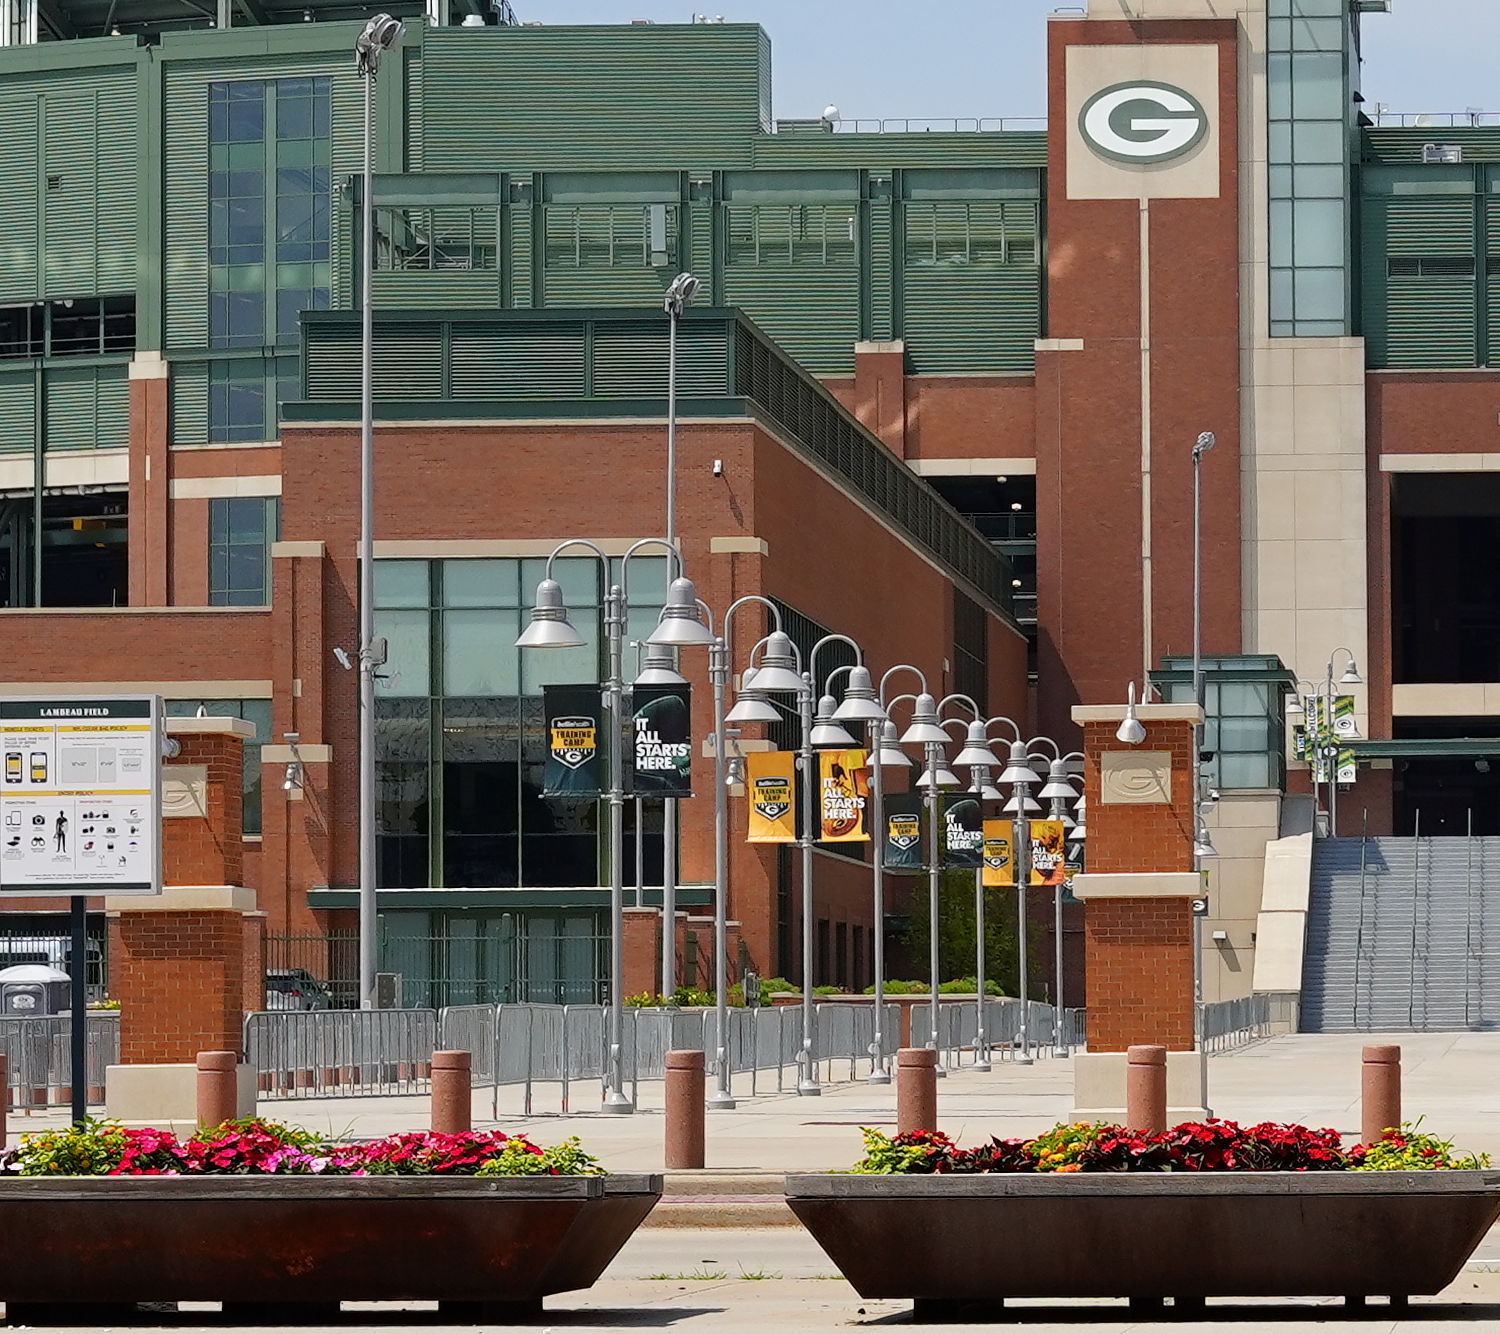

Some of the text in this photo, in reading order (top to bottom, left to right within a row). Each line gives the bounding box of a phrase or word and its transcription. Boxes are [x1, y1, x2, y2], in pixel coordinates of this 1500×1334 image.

[1084, 86, 1200, 157] G
[40, 708, 109, 716] LAMBEAU FIELD
[636, 718, 649, 731] IT
[556, 730, 592, 739] TRAINING
[636, 731, 662, 744] ALL
[636, 744, 687, 757] STARTS
[636, 757, 676, 770] HERE.
[823, 778, 834, 788] IT
[824, 788, 845, 798] ALL
[824, 798, 865, 808] STARTS
[824, 809, 856, 819] HERE.
[946, 814, 956, 823] IT
[946, 823, 964, 831] ALL
[946, 831, 982, 840] STARTS
